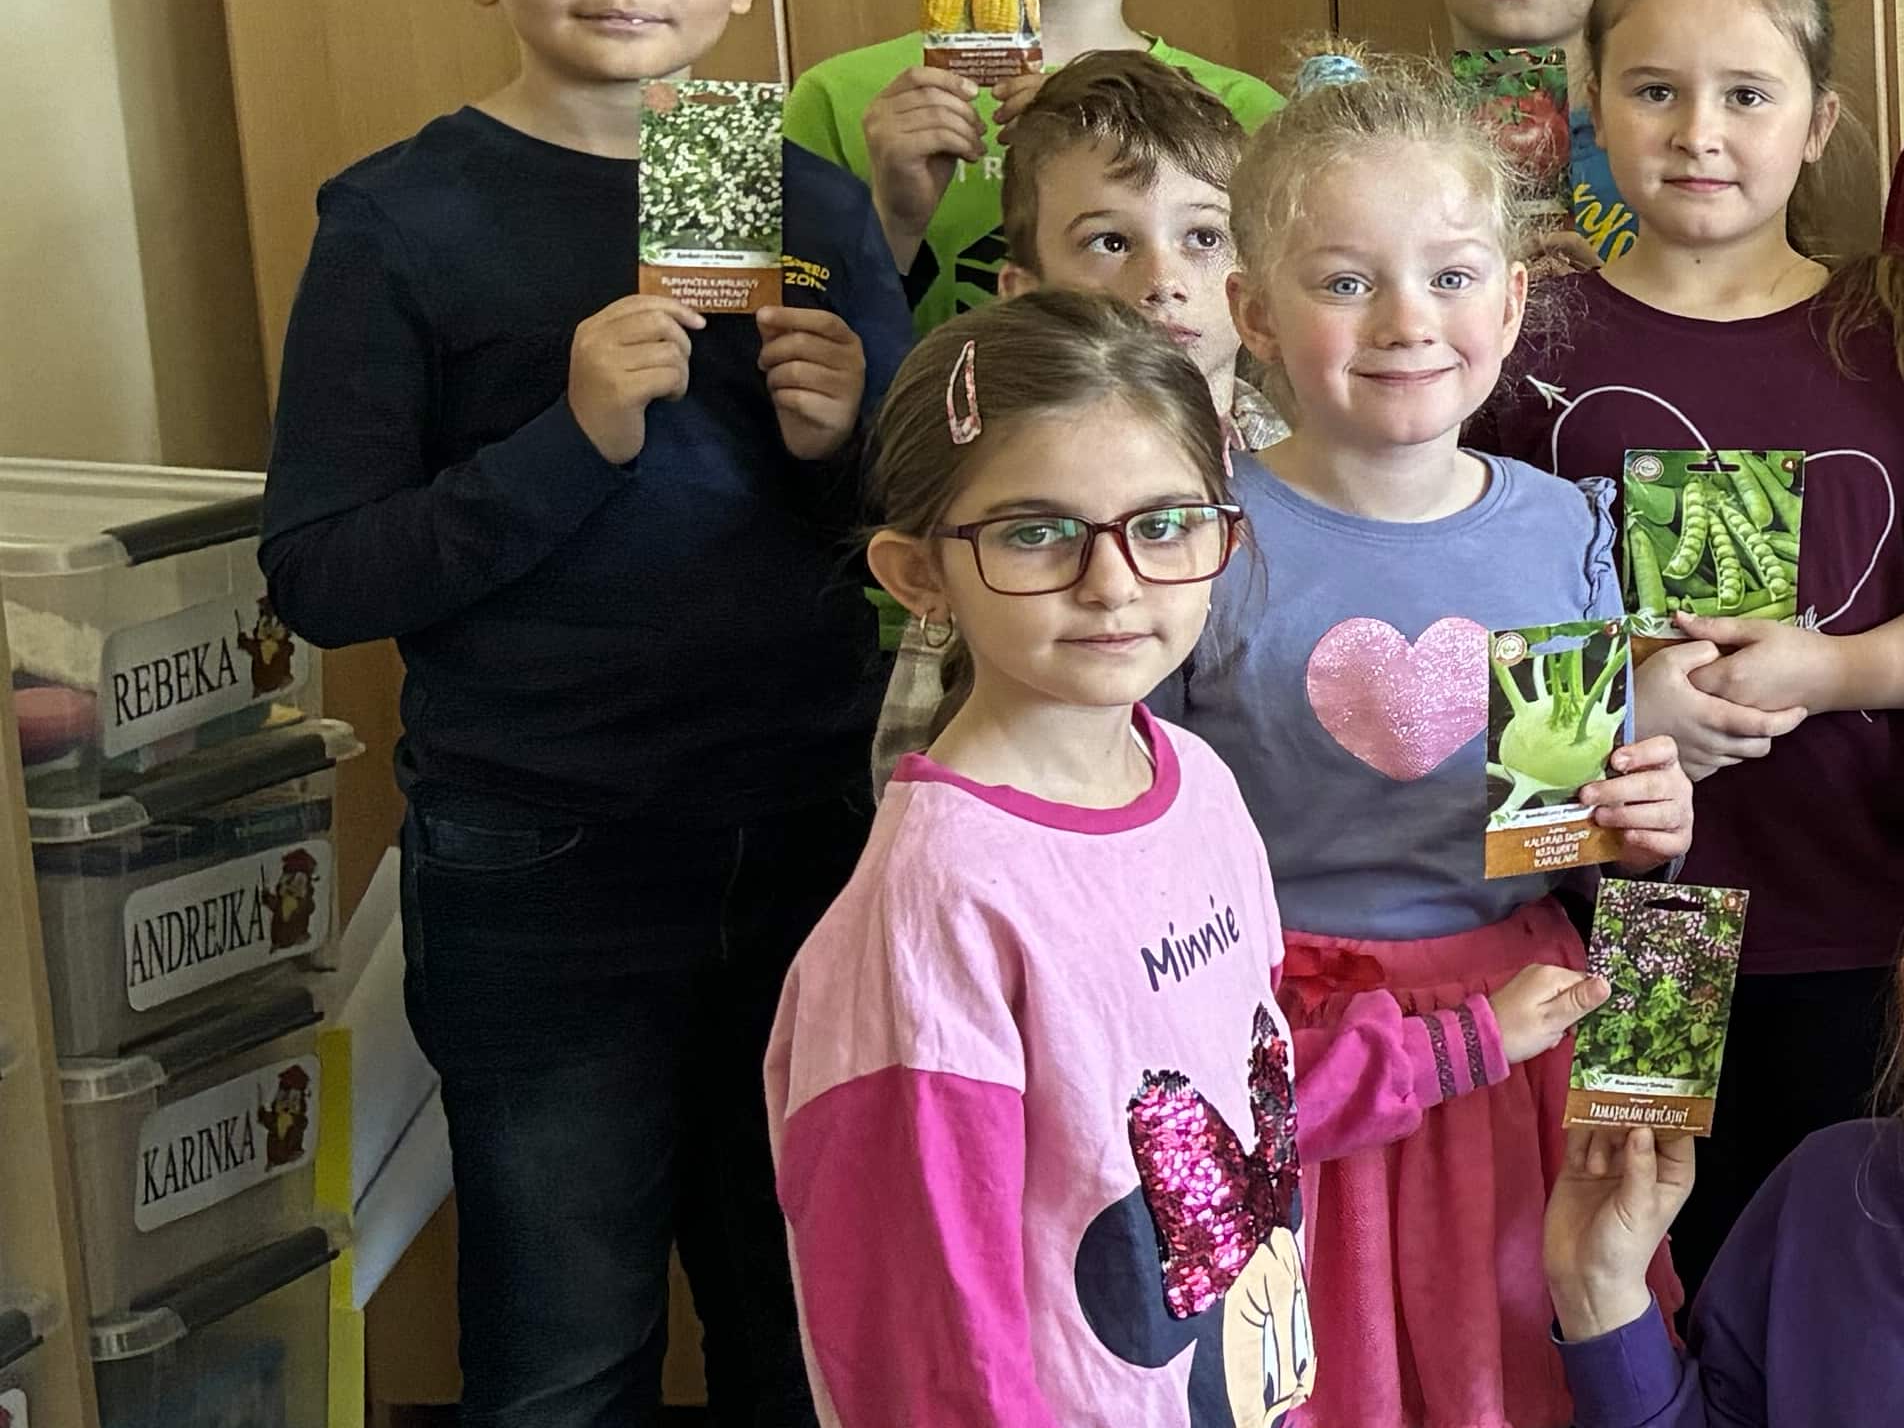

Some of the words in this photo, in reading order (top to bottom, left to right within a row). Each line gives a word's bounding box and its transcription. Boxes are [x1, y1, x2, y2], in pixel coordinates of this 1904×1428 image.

[112, 634, 239, 727] REBEKA
[128, 883, 265, 988] ANDREJKA
[1140, 894, 1240, 993] Minnie
[142, 1107, 257, 1207] KARINKA
